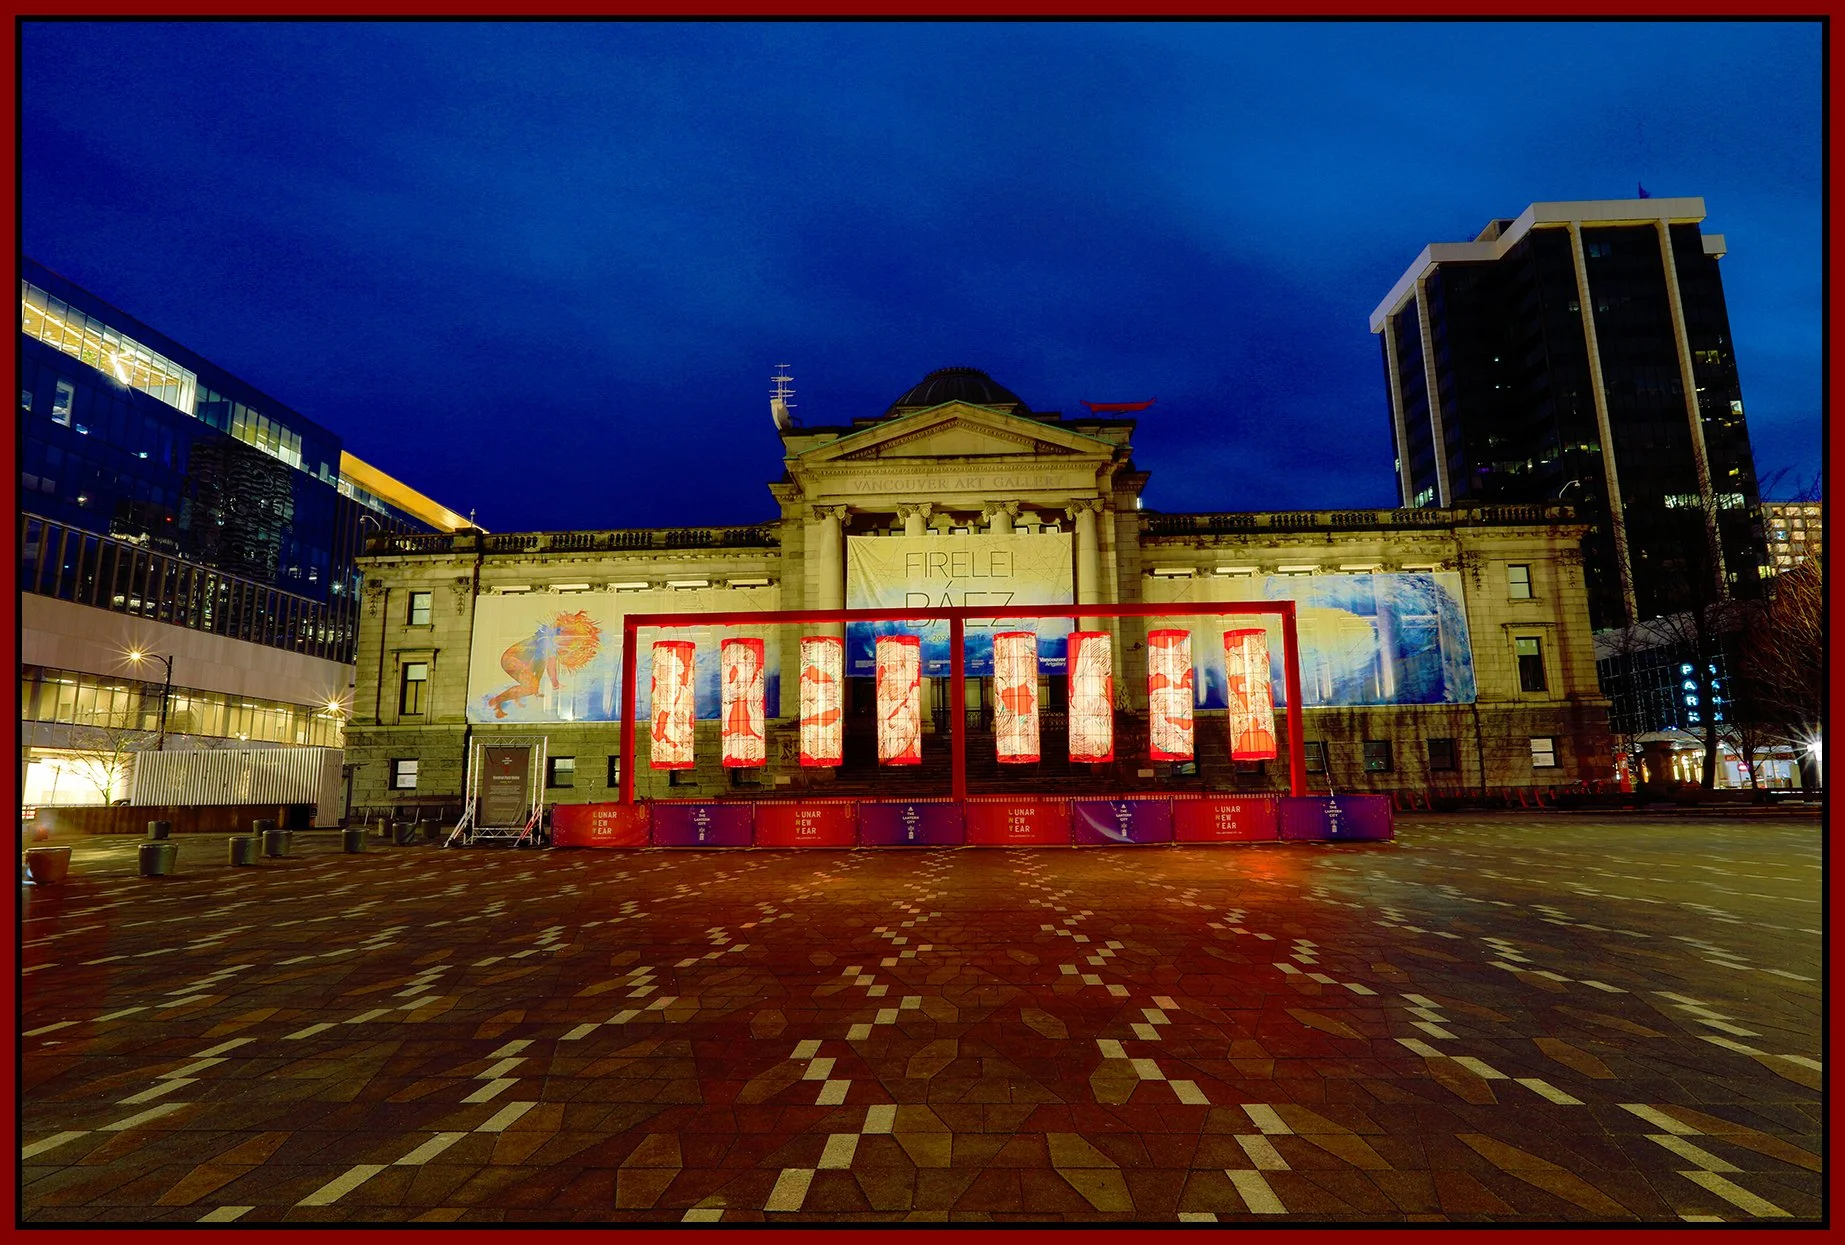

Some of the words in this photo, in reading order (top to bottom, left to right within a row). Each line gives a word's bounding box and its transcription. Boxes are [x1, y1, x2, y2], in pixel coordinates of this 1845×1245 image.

[854, 479, 949, 492] VANCOUVER
[955, 477, 985, 489] ART
[993, 475, 1064, 488] GALLERY
[905, 551, 1014, 578] FIRELEI
[1682, 665, 1700, 722] PARK
[1008, 808, 1035, 816] LUNAR
[1215, 805, 1241, 813] LUNAR
[592, 811, 617, 819] LUNAR
[1215, 814, 1232, 822] NEW
[1008, 825, 1030, 833] YEAR
[1215, 822, 1237, 830] YEAR
[795, 827, 817, 835] YEAR
